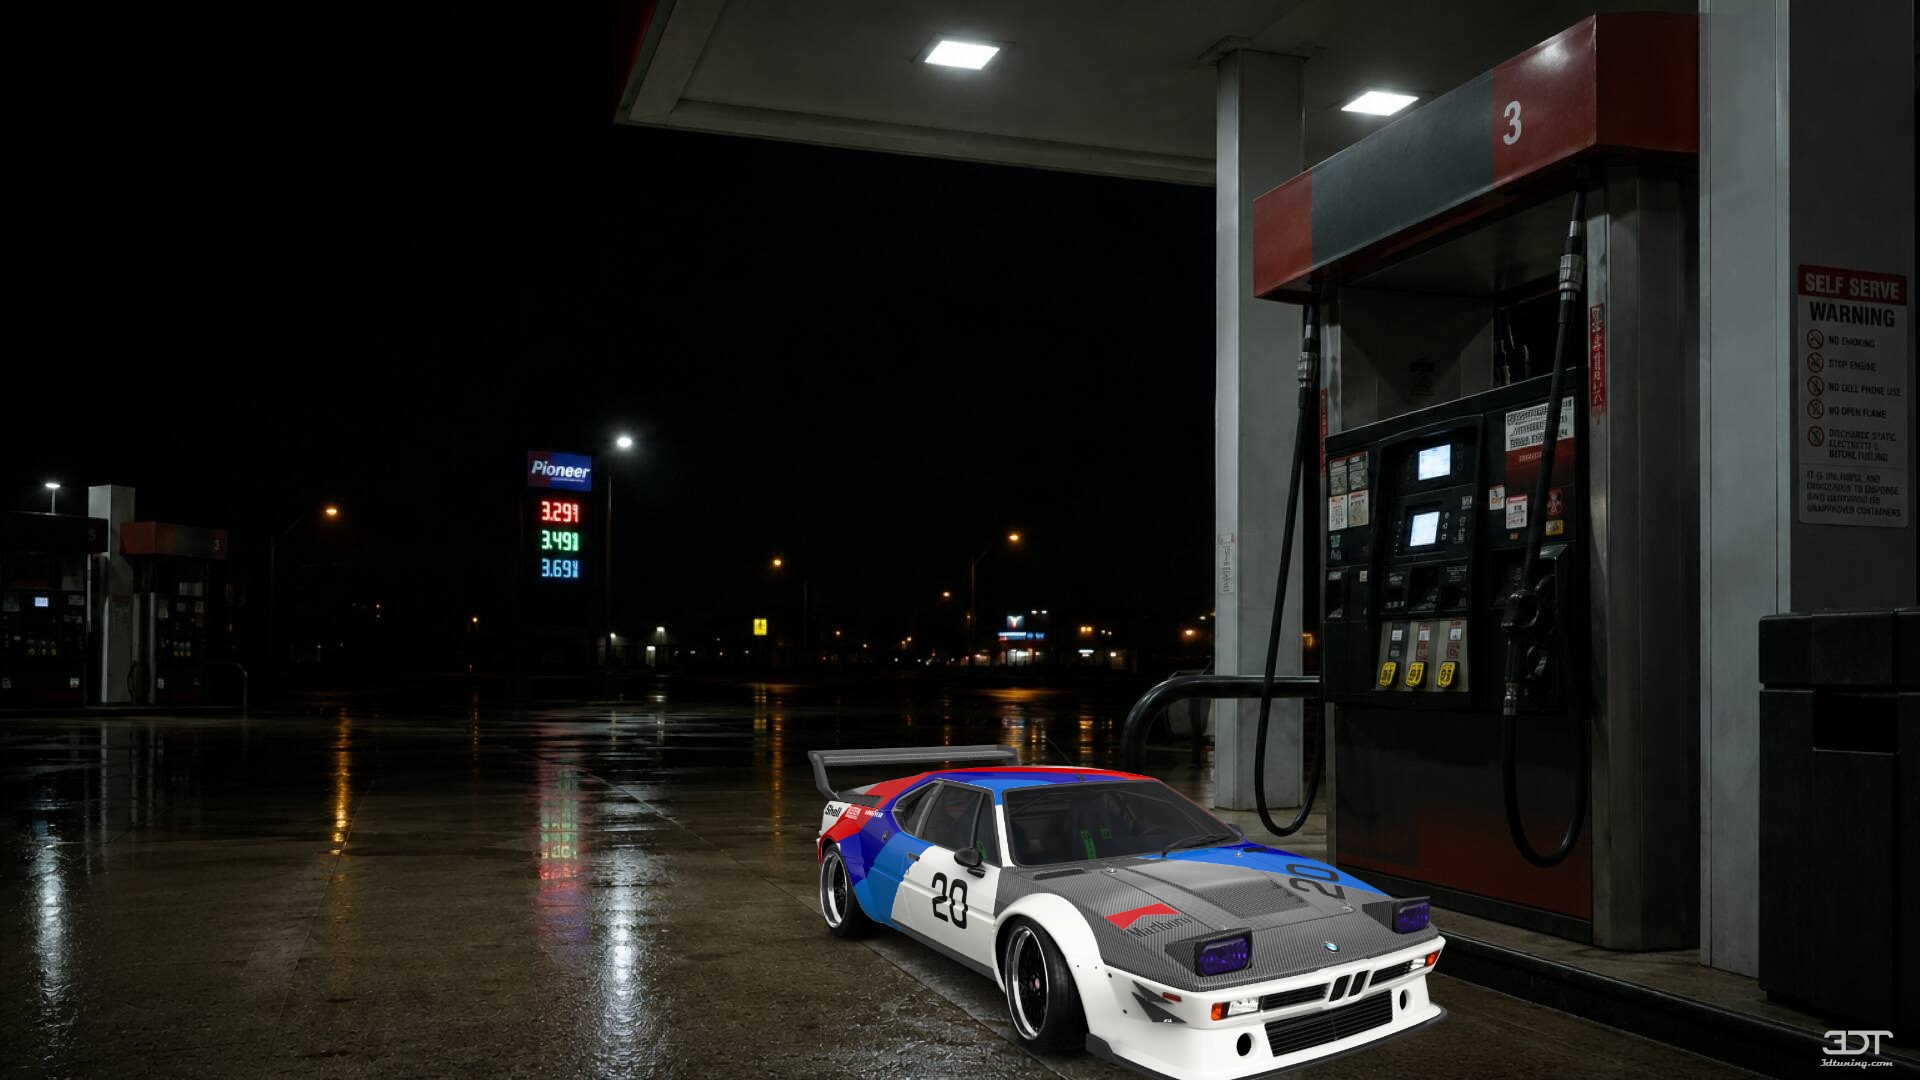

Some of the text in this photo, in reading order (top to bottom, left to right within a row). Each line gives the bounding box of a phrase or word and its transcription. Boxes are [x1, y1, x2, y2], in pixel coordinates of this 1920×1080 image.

[1503, 100, 1522, 146] 3
[1804, 271, 1900, 300] SELF SERVE
[1809, 301, 1895, 328] WARNING
[531, 459, 591, 479] Pioneer
[825, 804, 843, 817] Shell
[1286, 863, 1346, 900] 20
[931, 872, 969, 929] 20
[1126, 917, 1194, 940] Marlboro
